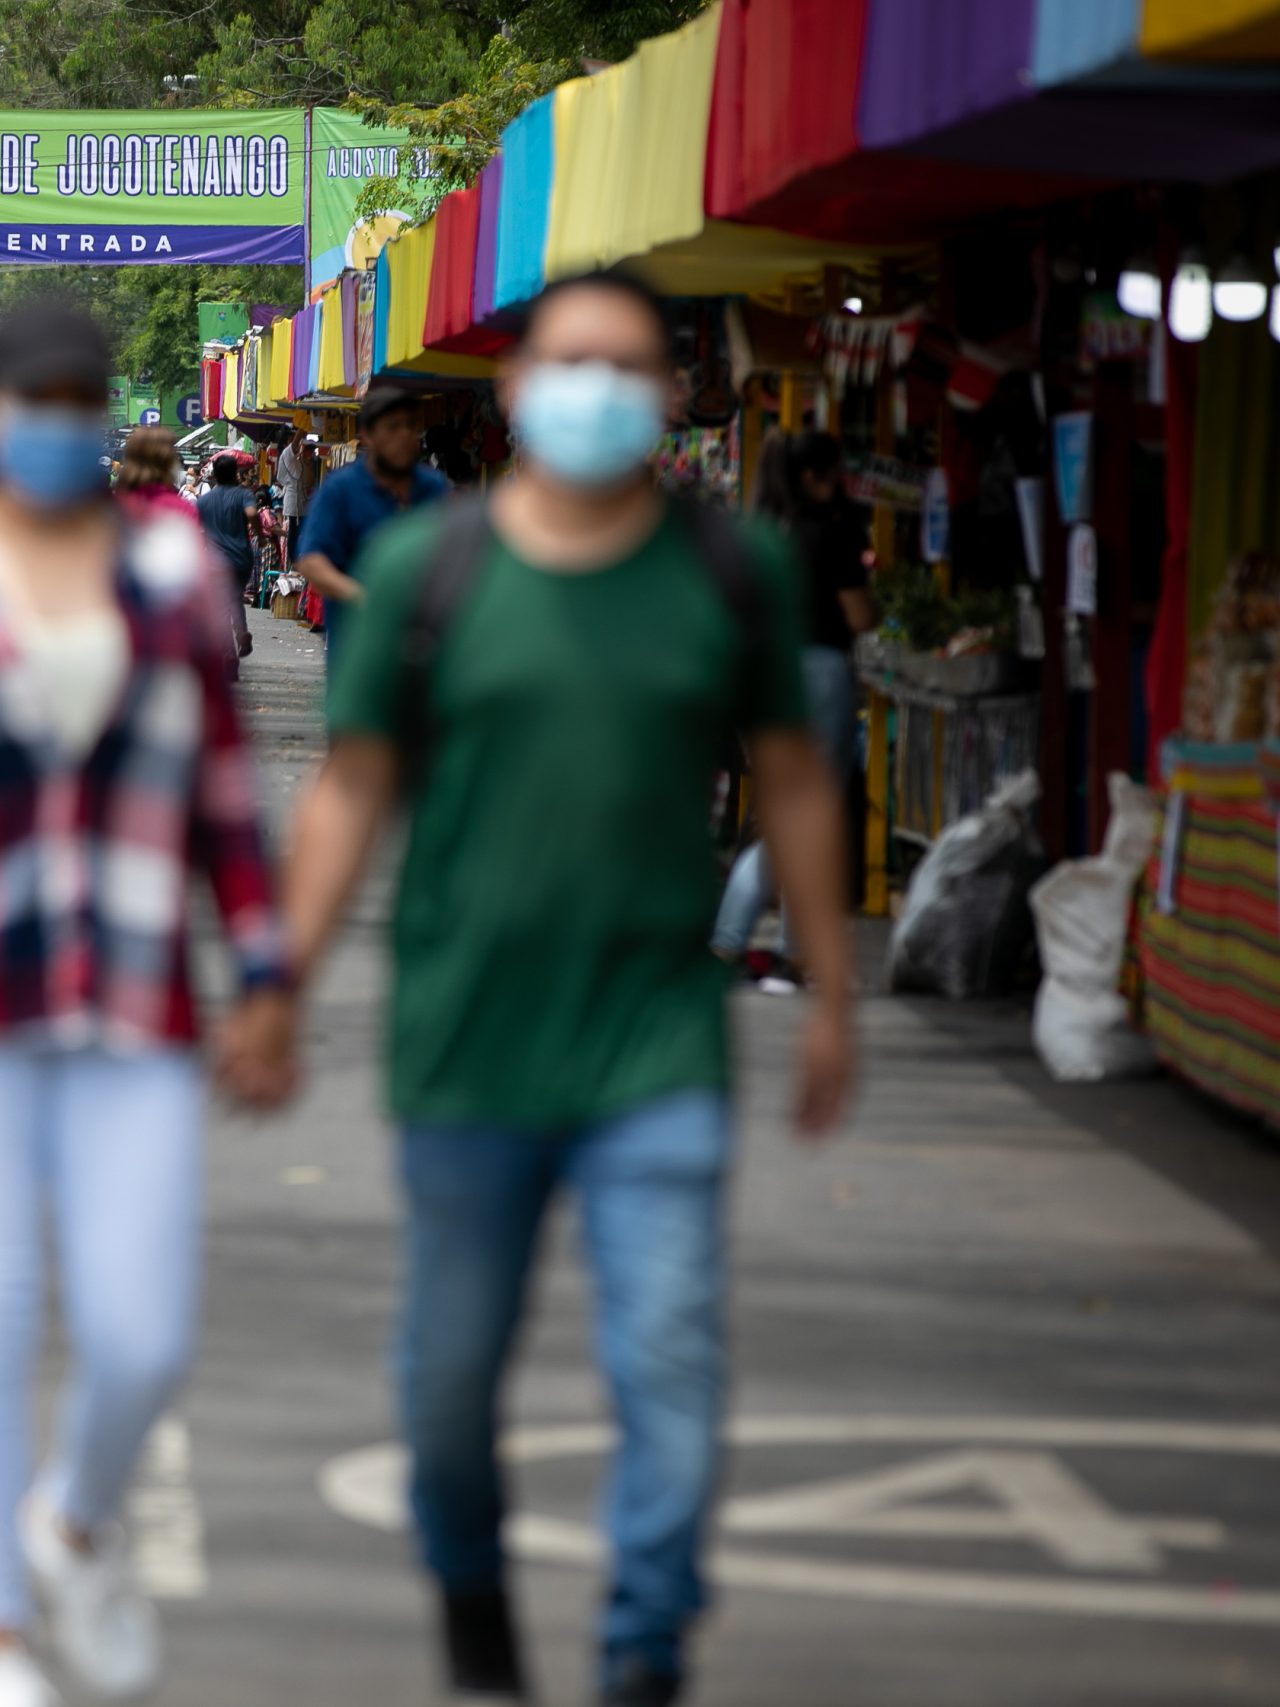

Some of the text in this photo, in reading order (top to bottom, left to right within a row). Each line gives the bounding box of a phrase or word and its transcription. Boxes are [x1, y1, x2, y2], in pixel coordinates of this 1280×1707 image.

[1, 133, 40, 195] DE
[57, 134, 289, 197] JOCOTENANGO
[326, 146, 399, 178] AGOSTO
[7, 234, 172, 252] ENTRADA
